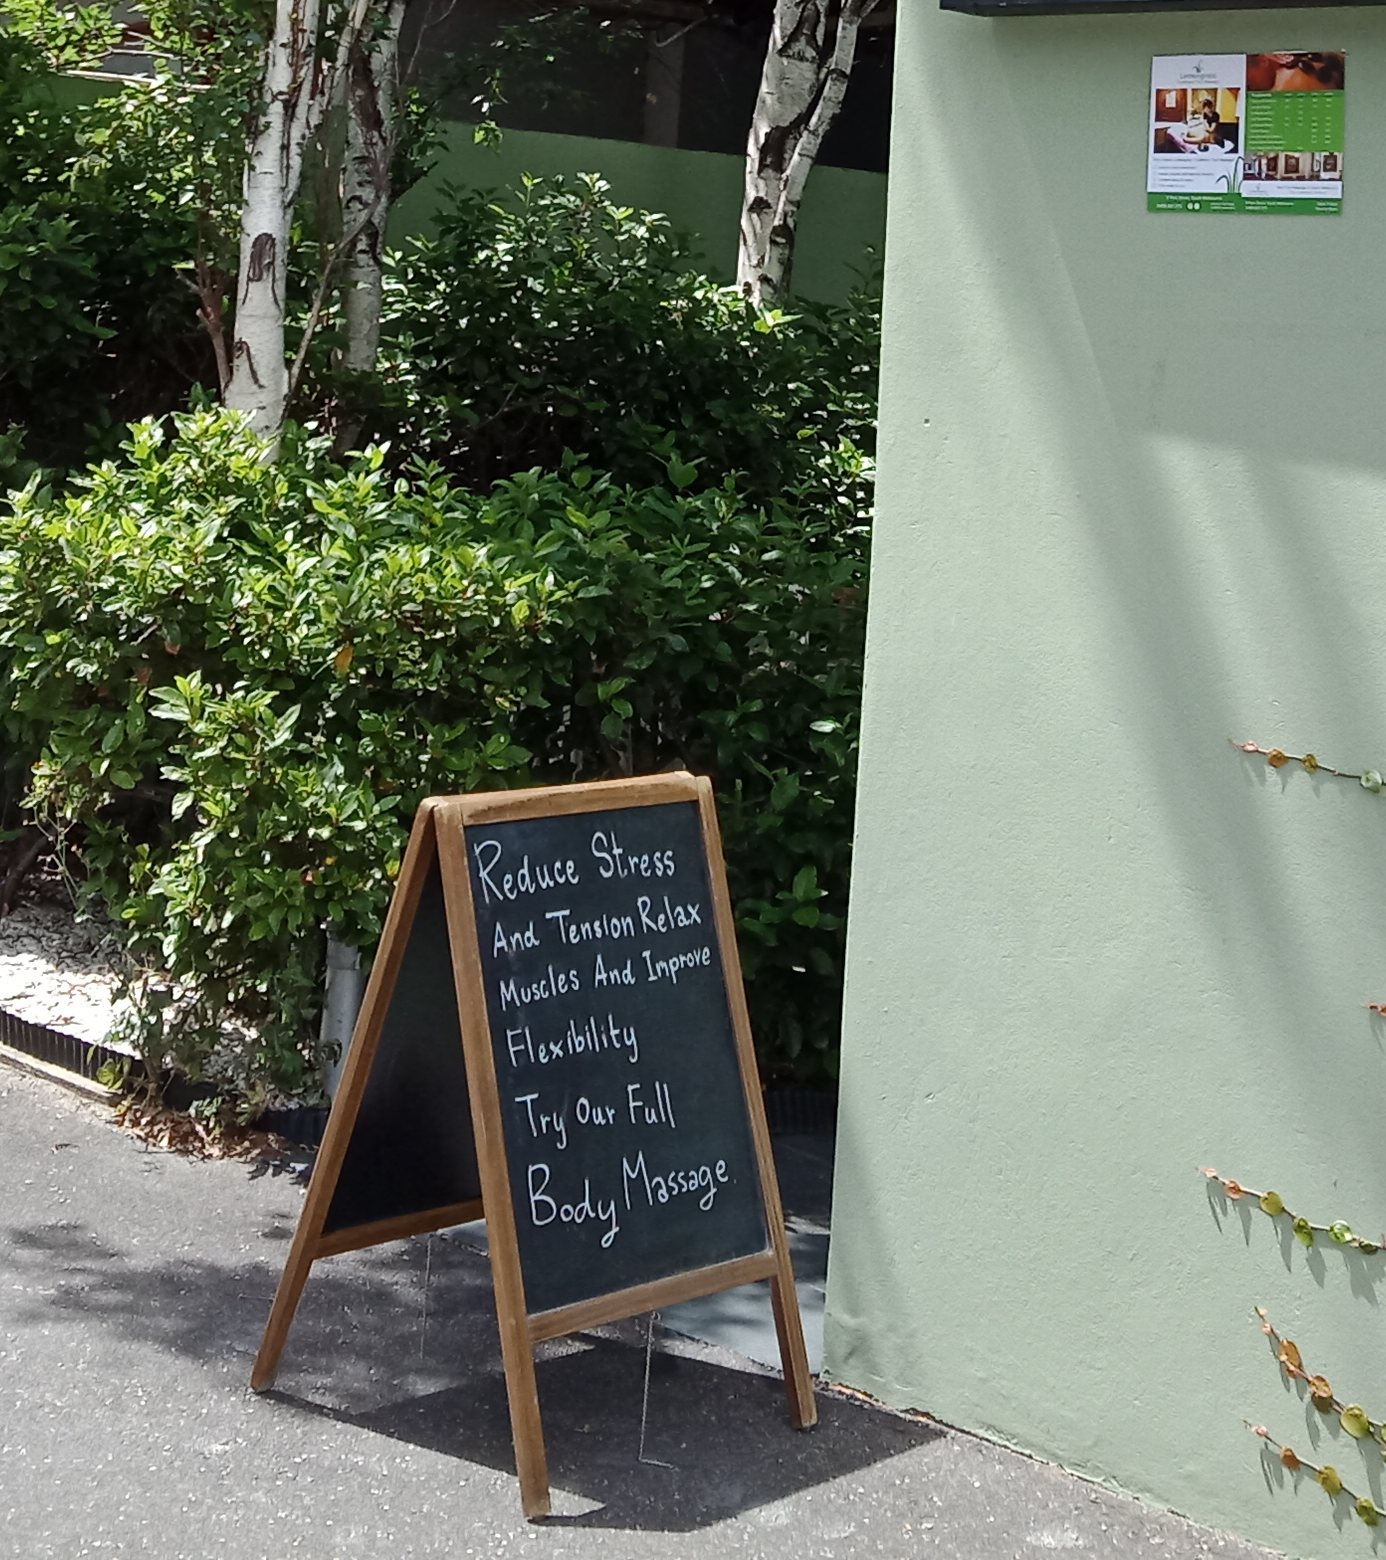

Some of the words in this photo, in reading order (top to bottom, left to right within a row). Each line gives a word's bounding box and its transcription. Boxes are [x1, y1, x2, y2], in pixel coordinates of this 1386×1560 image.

[473, 840, 580, 904] Reduce
[591, 830, 675, 878] Stress
[493, 921, 540, 958] And
[545, 909, 635, 944] Tension
[637, 895, 701, 933] Relax
[500, 964, 580, 1011] Muscles
[594, 953, 636, 988] And
[642, 946, 711, 984] Improve
[506, 1014, 639, 1067] Flexibility
[515, 1093, 567, 1150] Try
[576, 1097, 615, 1125] Our
[627, 1081, 675, 1128] Full
[528, 1163, 620, 1248] Body
